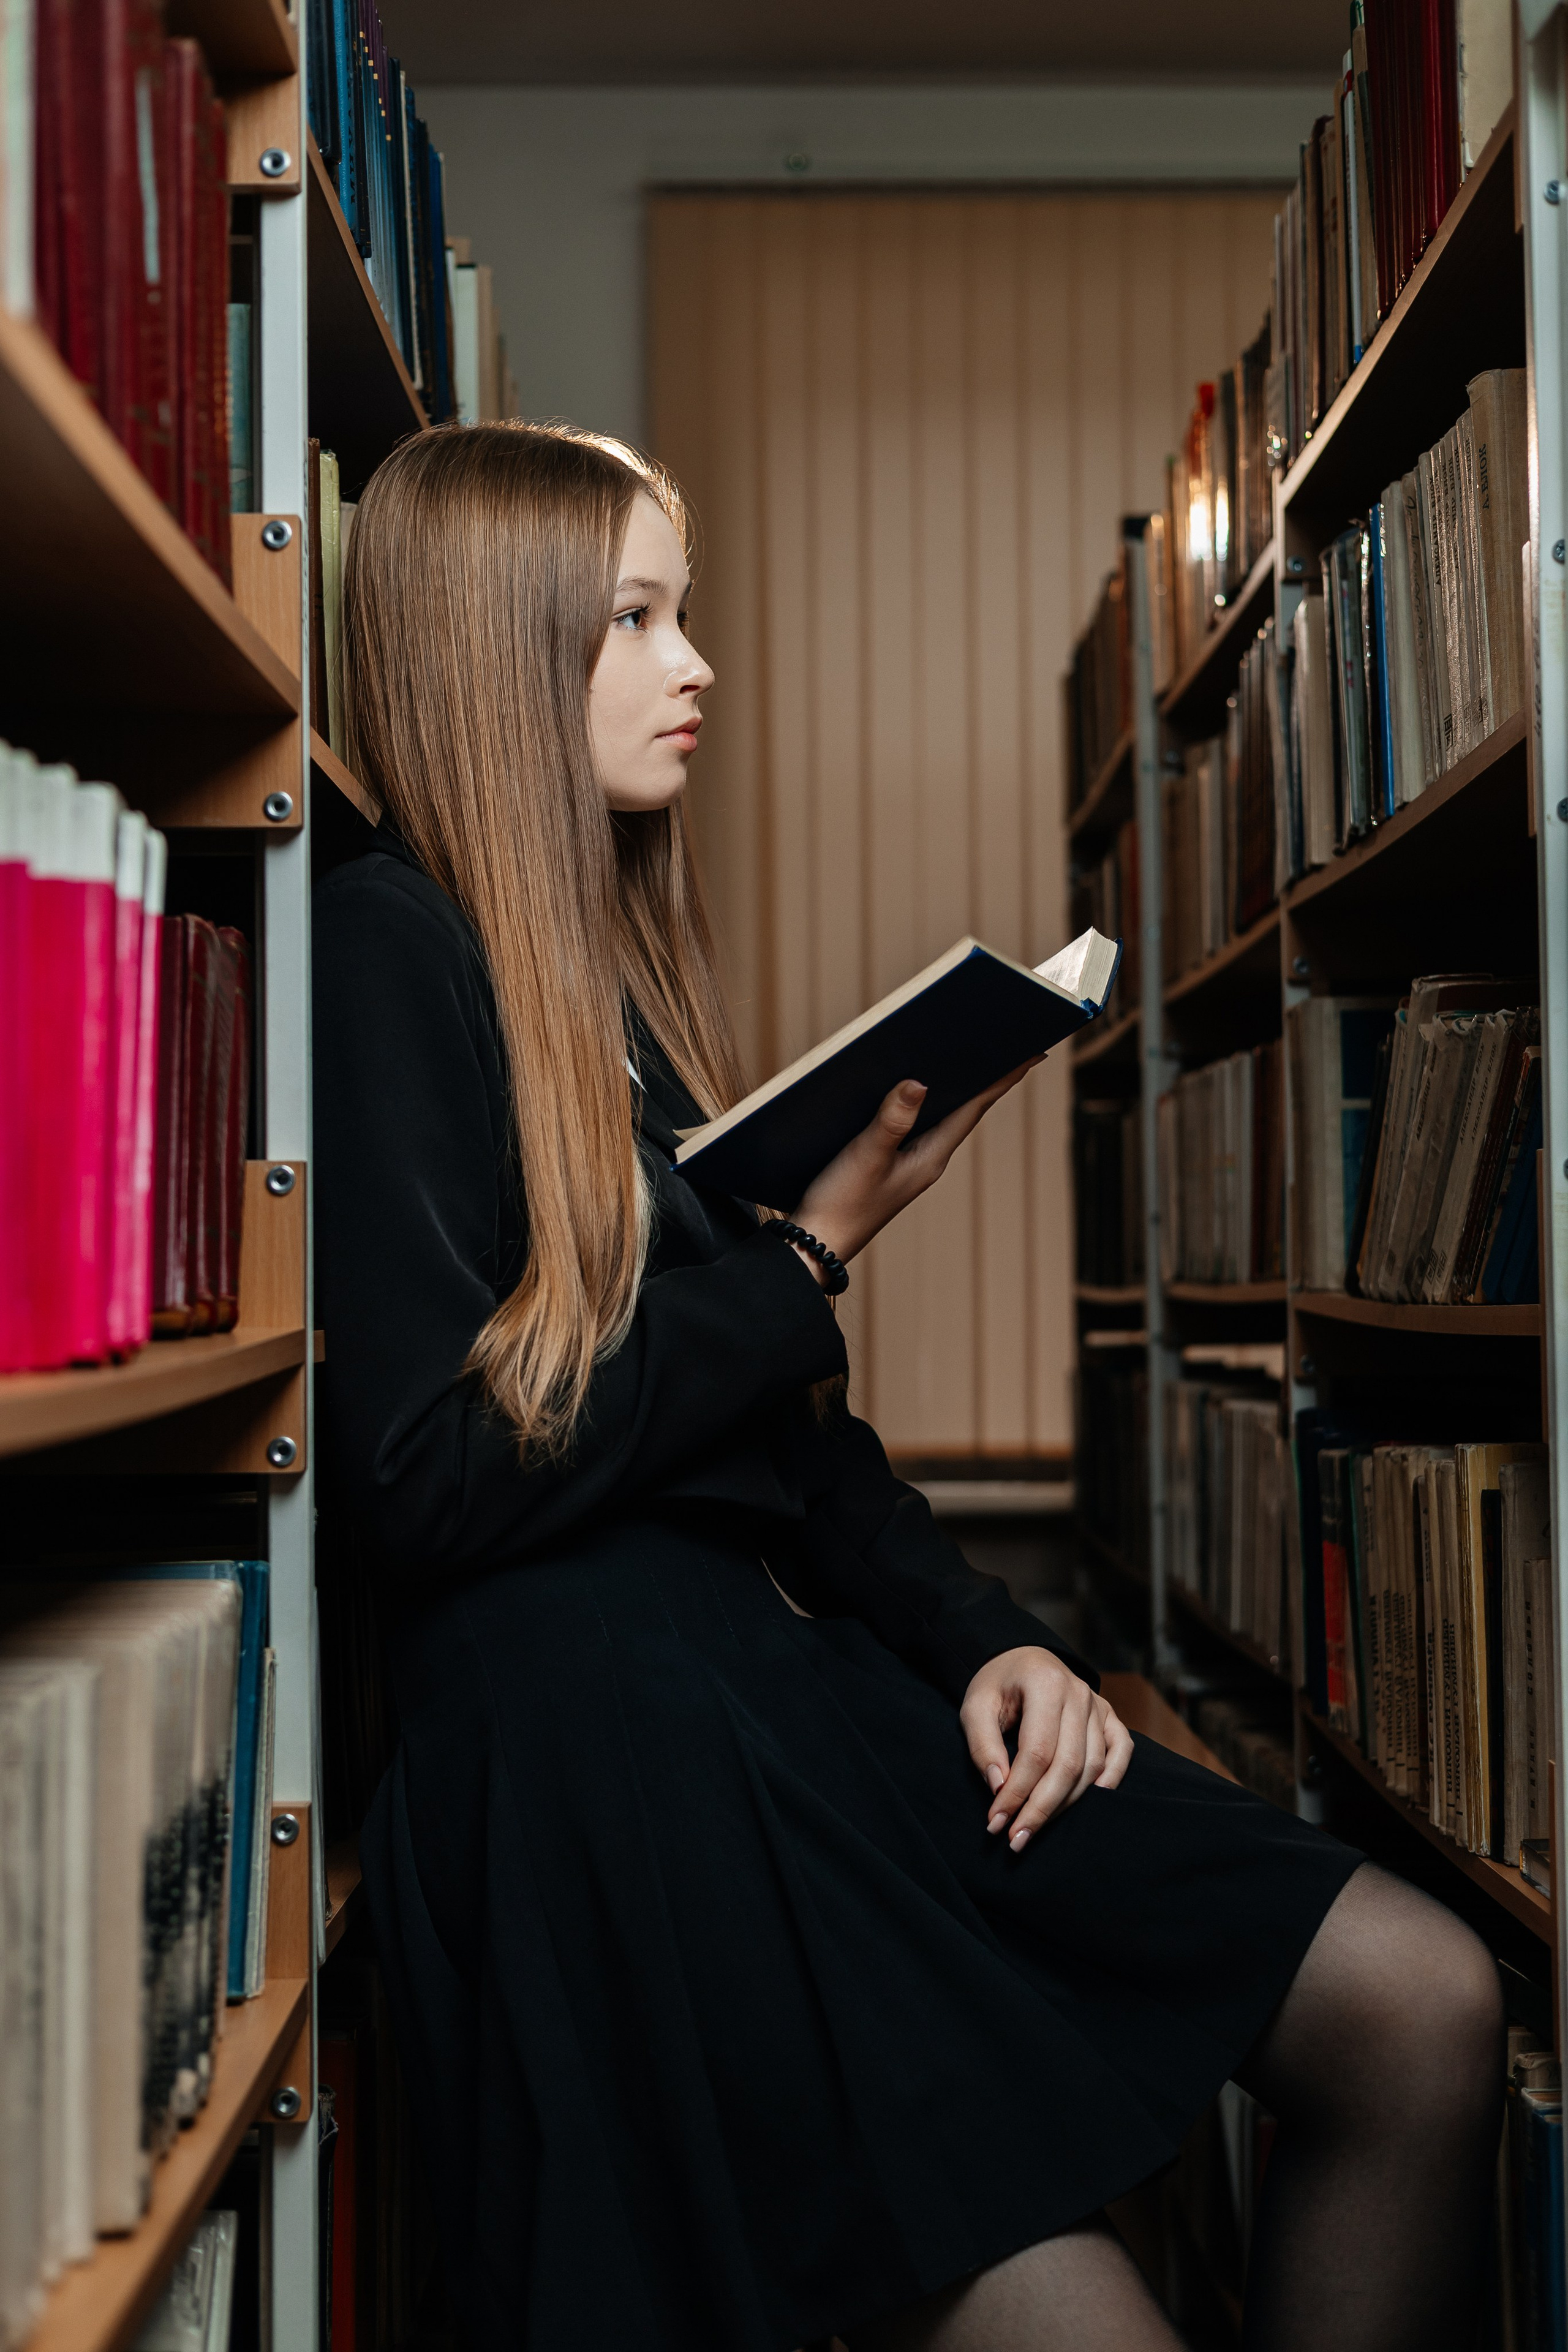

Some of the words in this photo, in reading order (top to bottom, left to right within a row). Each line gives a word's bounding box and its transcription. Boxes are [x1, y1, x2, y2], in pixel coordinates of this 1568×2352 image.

[1431, 514, 1441, 586] АЛЕКСАНДР
[1459, 1077, 1476, 1145] АЛЕКСАНДР
[1475, 1042, 1485, 1074] БЛОК
[1471, 1077, 1488, 1144] АЛЕКСАНДР
[1487, 1040, 1497, 1074] БЛОК
[1450, 1624, 1458, 1708] ГУМИЛЕВ
[1525, 1600, 1533, 1695] СОЛОВЬИ
